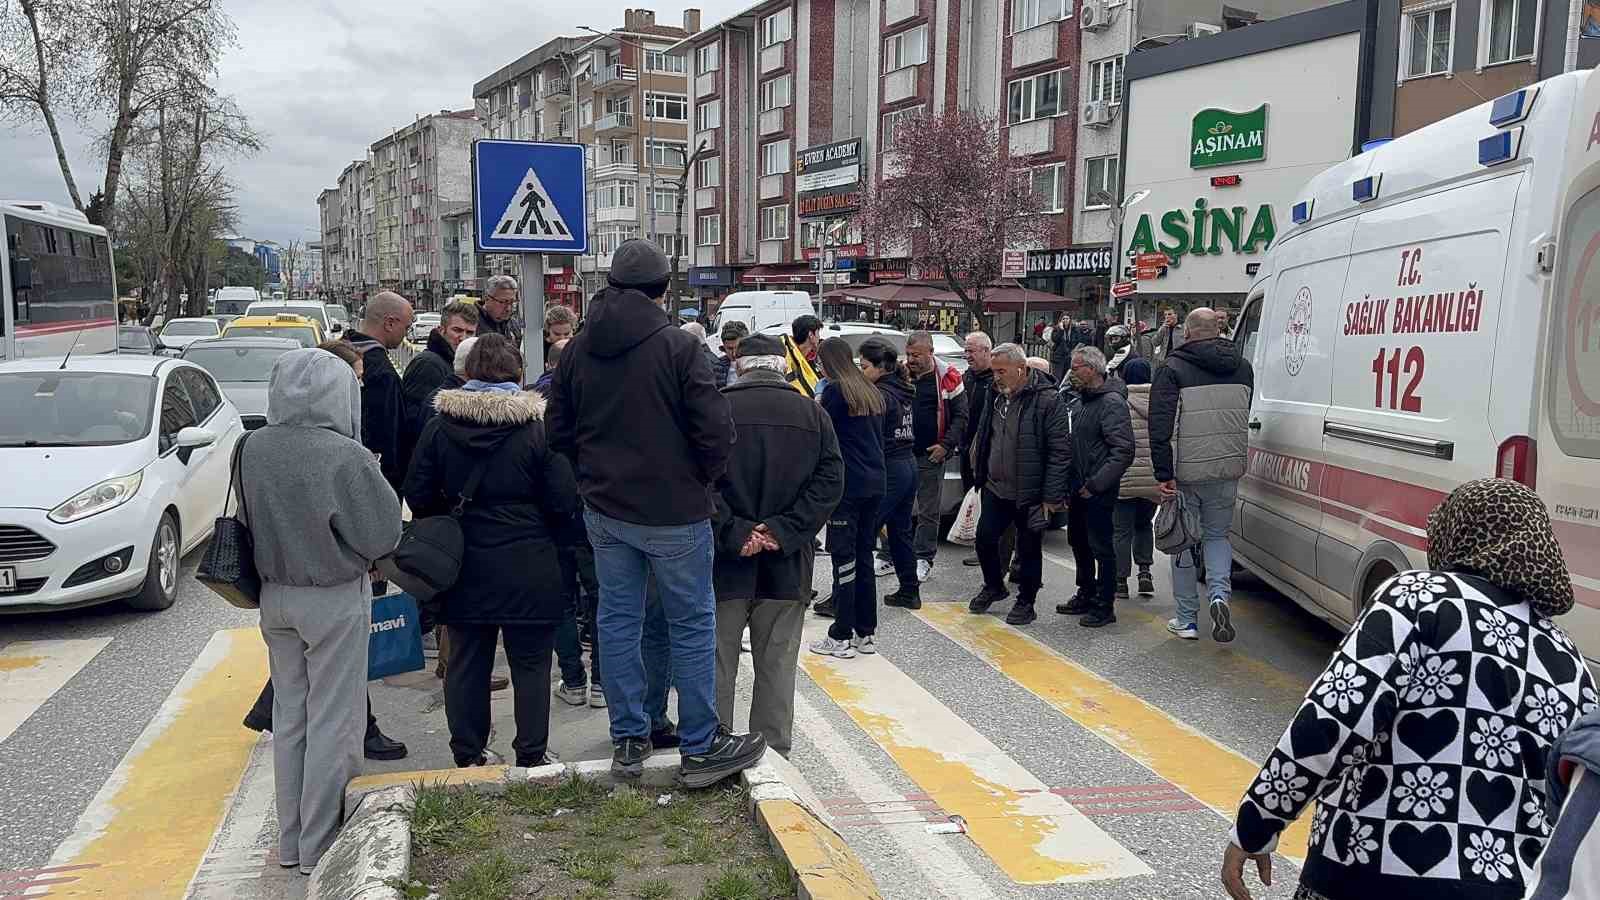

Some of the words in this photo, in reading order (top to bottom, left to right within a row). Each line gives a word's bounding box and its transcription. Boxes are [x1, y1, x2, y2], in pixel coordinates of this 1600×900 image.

[804, 150, 825, 166] EVREN
[825, 141, 857, 161] ACADEMY
[1126, 198, 1277, 268] AŞİNA
[1054, 247, 1112, 273] BÖREKÇİS
[1397, 248, 1421, 286] T.C.
[1344, 294, 1389, 335] SAĞLIK
[1392, 281, 1484, 333] BAKANLIĞI
[1372, 346, 1425, 413] 112
[1250, 451, 1311, 491] AMBULANS
[369, 614, 406, 634] mavi
